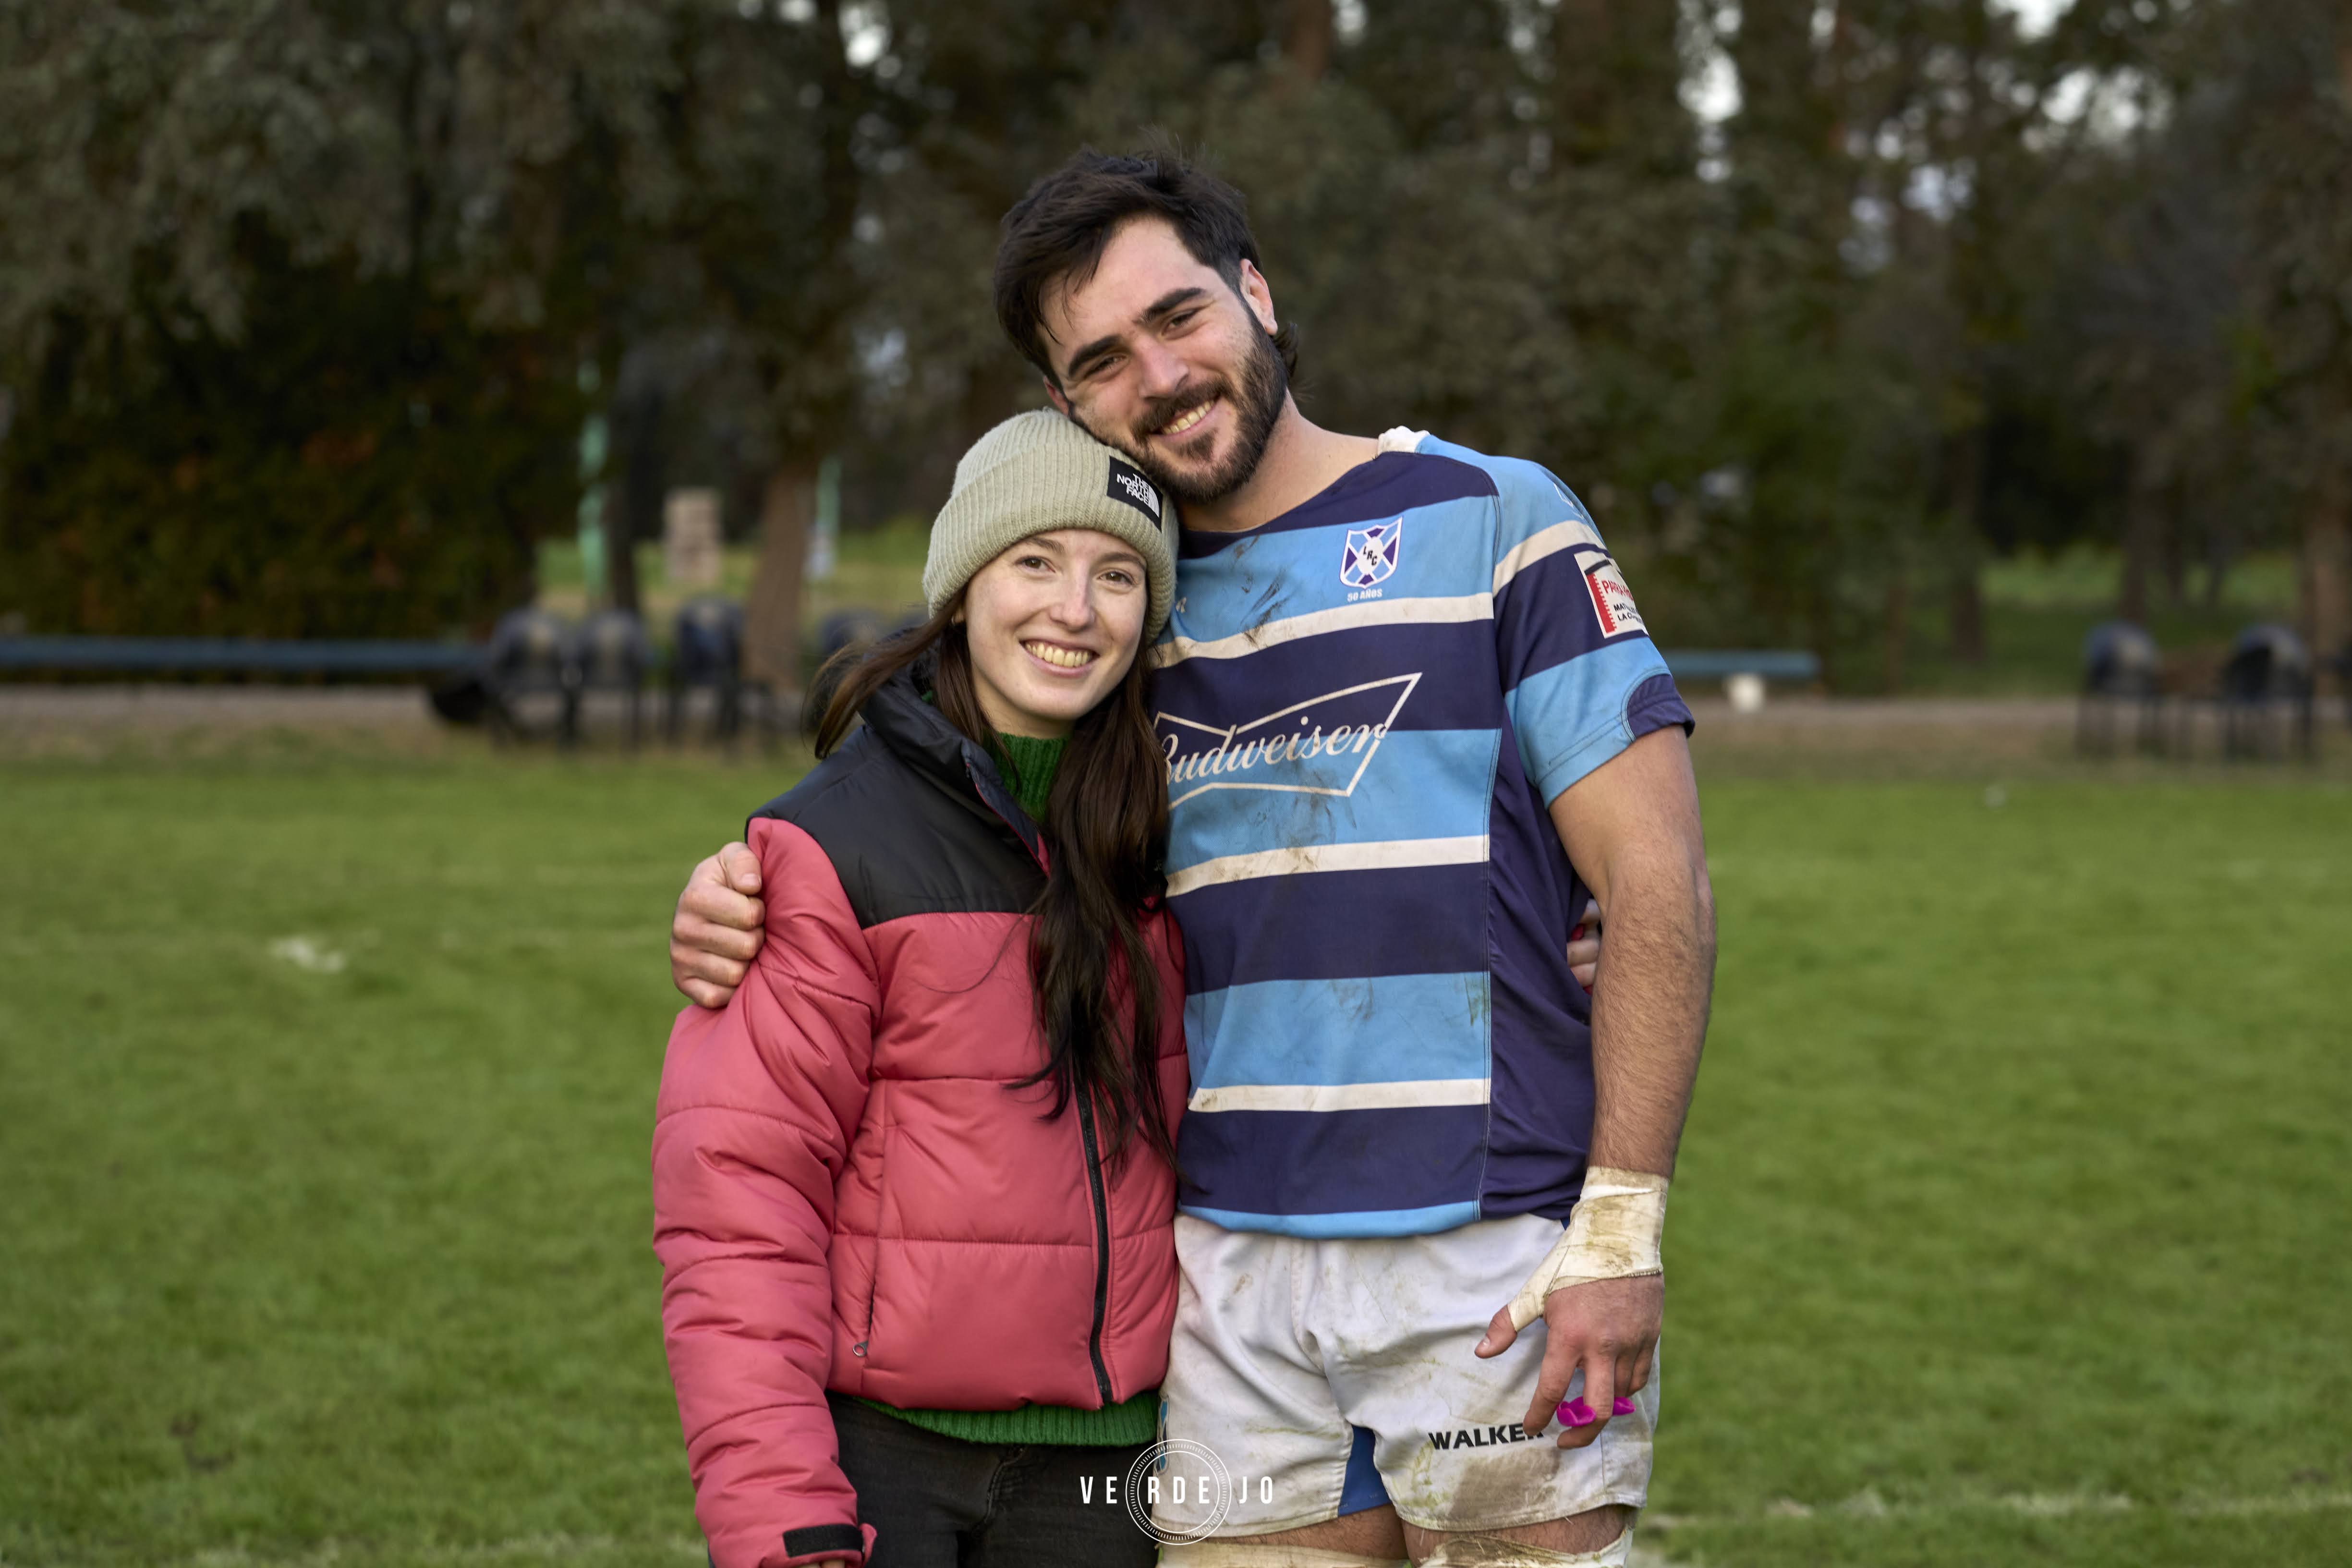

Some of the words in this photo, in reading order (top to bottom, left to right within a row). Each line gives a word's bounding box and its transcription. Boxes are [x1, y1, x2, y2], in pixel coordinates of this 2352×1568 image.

[1116, 473, 1149, 498] NORTH
[1133, 473, 1149, 489] THE
[1126, 486, 1149, 505] FACE
[1428, 1422, 1544, 1450] WALKE
